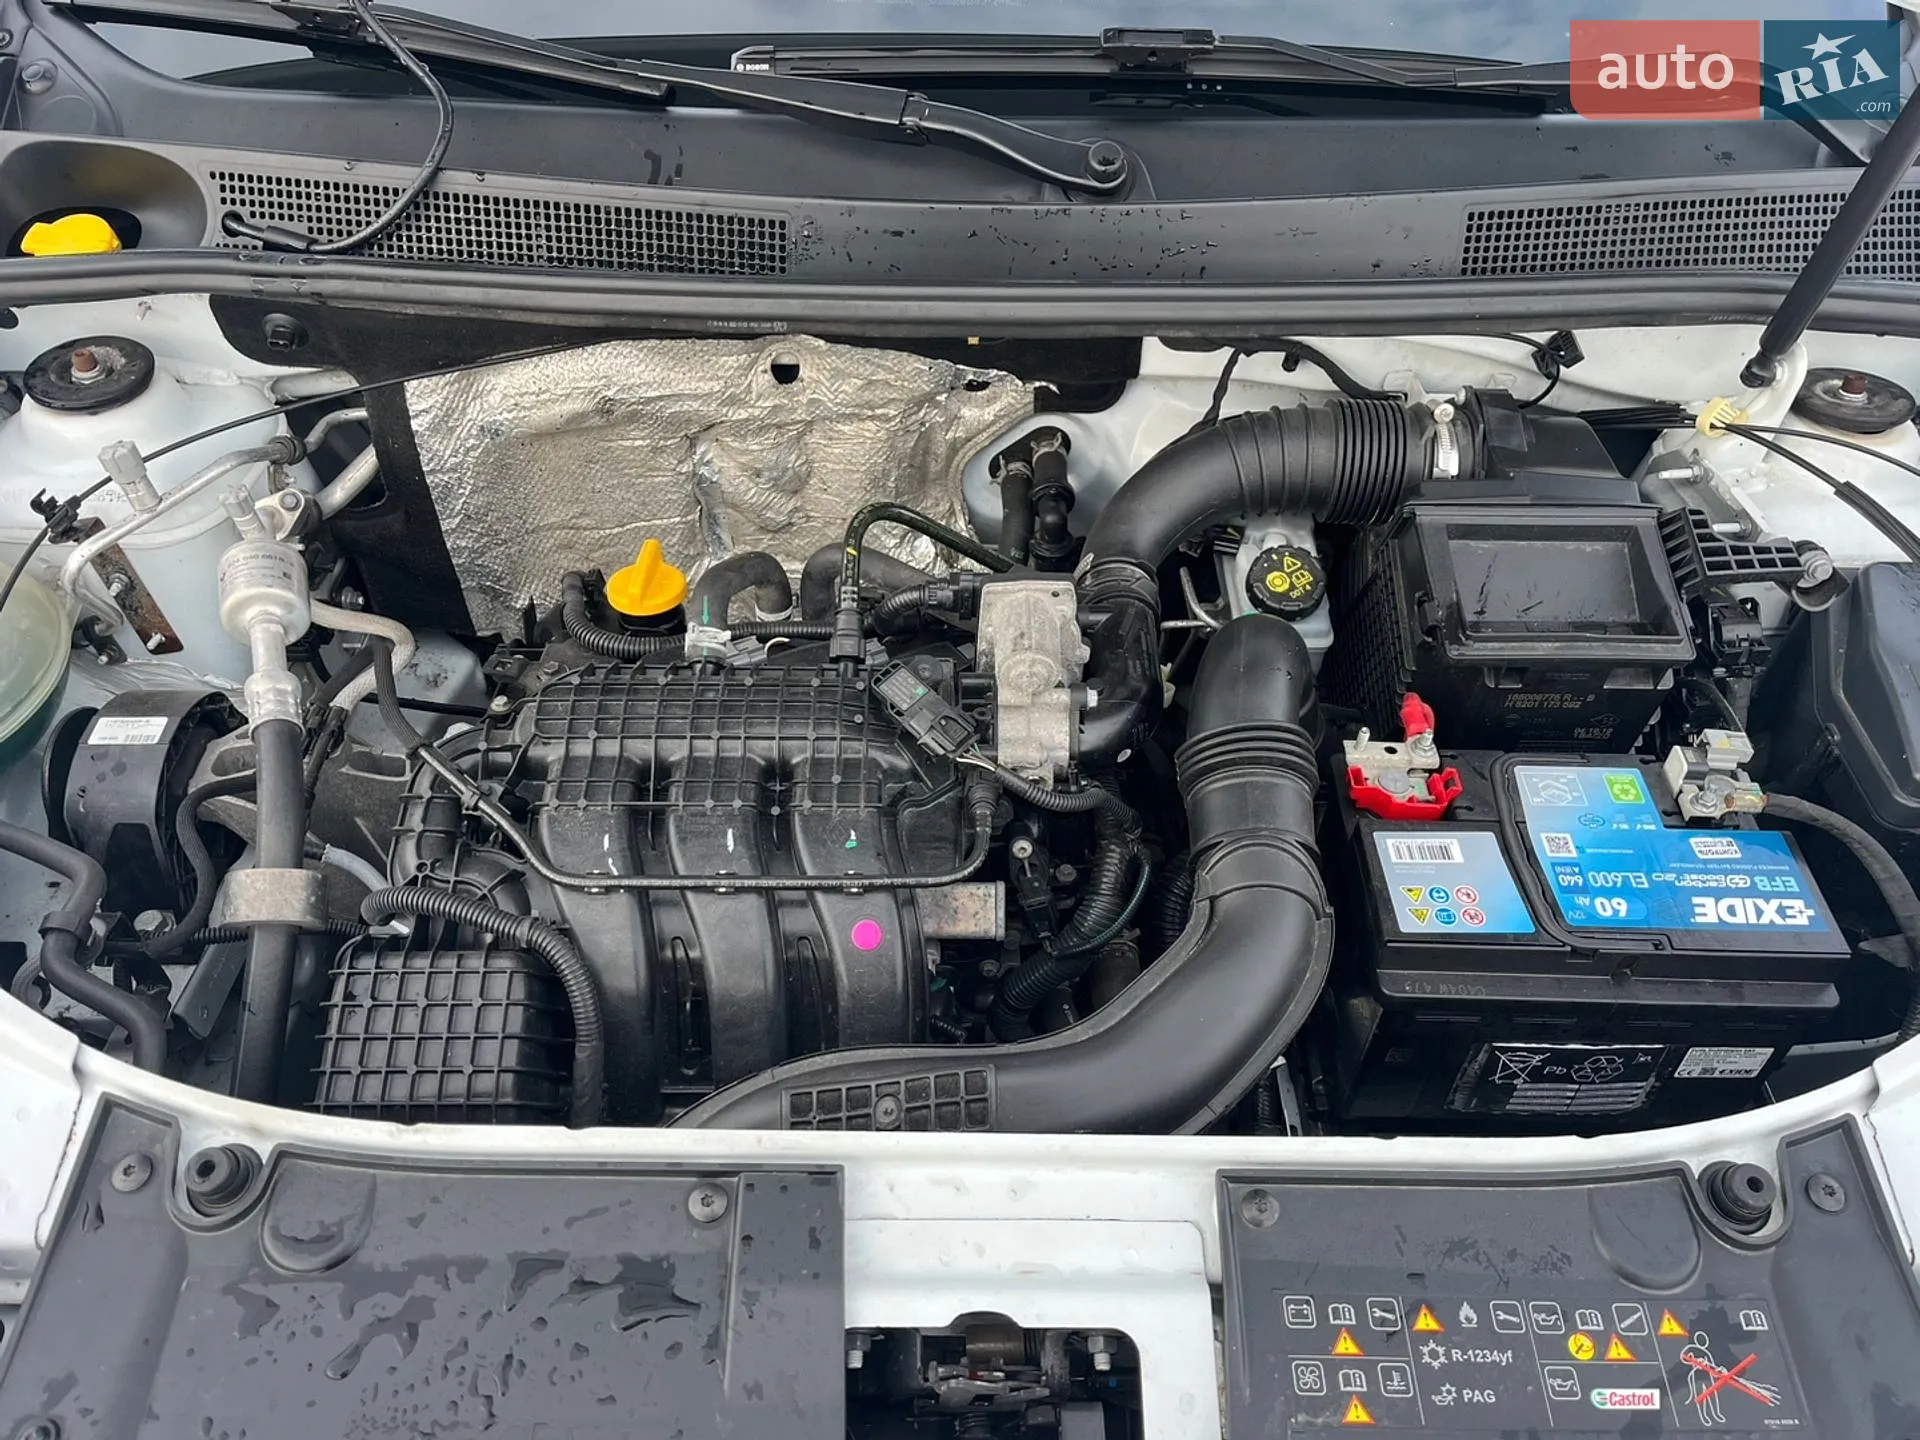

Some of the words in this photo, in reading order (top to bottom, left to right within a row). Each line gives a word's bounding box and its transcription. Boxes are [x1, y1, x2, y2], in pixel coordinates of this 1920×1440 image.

[1558, 874, 1583, 886] 640
[1588, 871, 1649, 888] EL600
[1754, 875, 1800, 892] EFB
[1574, 895, 1591, 907] Ah
[1594, 896, 1628, 918] 60
[1691, 896, 1816, 925] EXIDE
[1543, 1065, 1567, 1075] Pb
[1451, 1349, 1513, 1366] R-1234yf
[1462, 1389, 1496, 1403] PAG
[1609, 1391, 1656, 1406] Castrol
